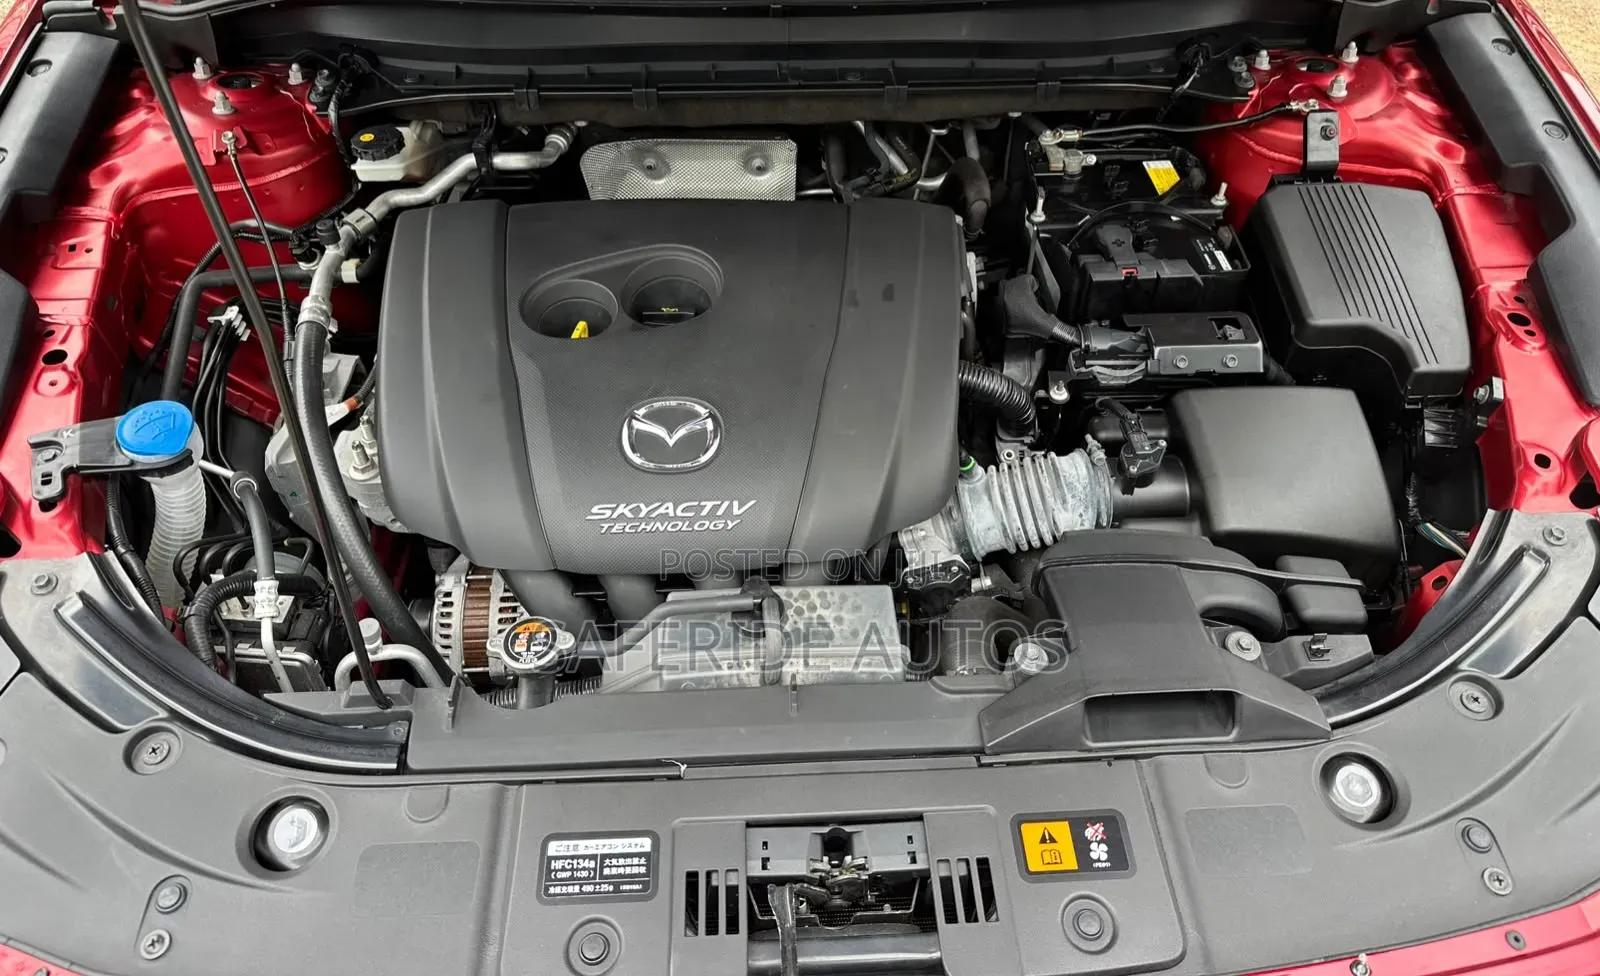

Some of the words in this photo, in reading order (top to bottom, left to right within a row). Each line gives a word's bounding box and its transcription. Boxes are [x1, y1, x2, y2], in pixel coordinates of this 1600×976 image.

[585, 500, 757, 520] SKYACTIV
[599, 519, 742, 534] TECHNOLOGY
[550, 858, 596, 870] HFC134a
